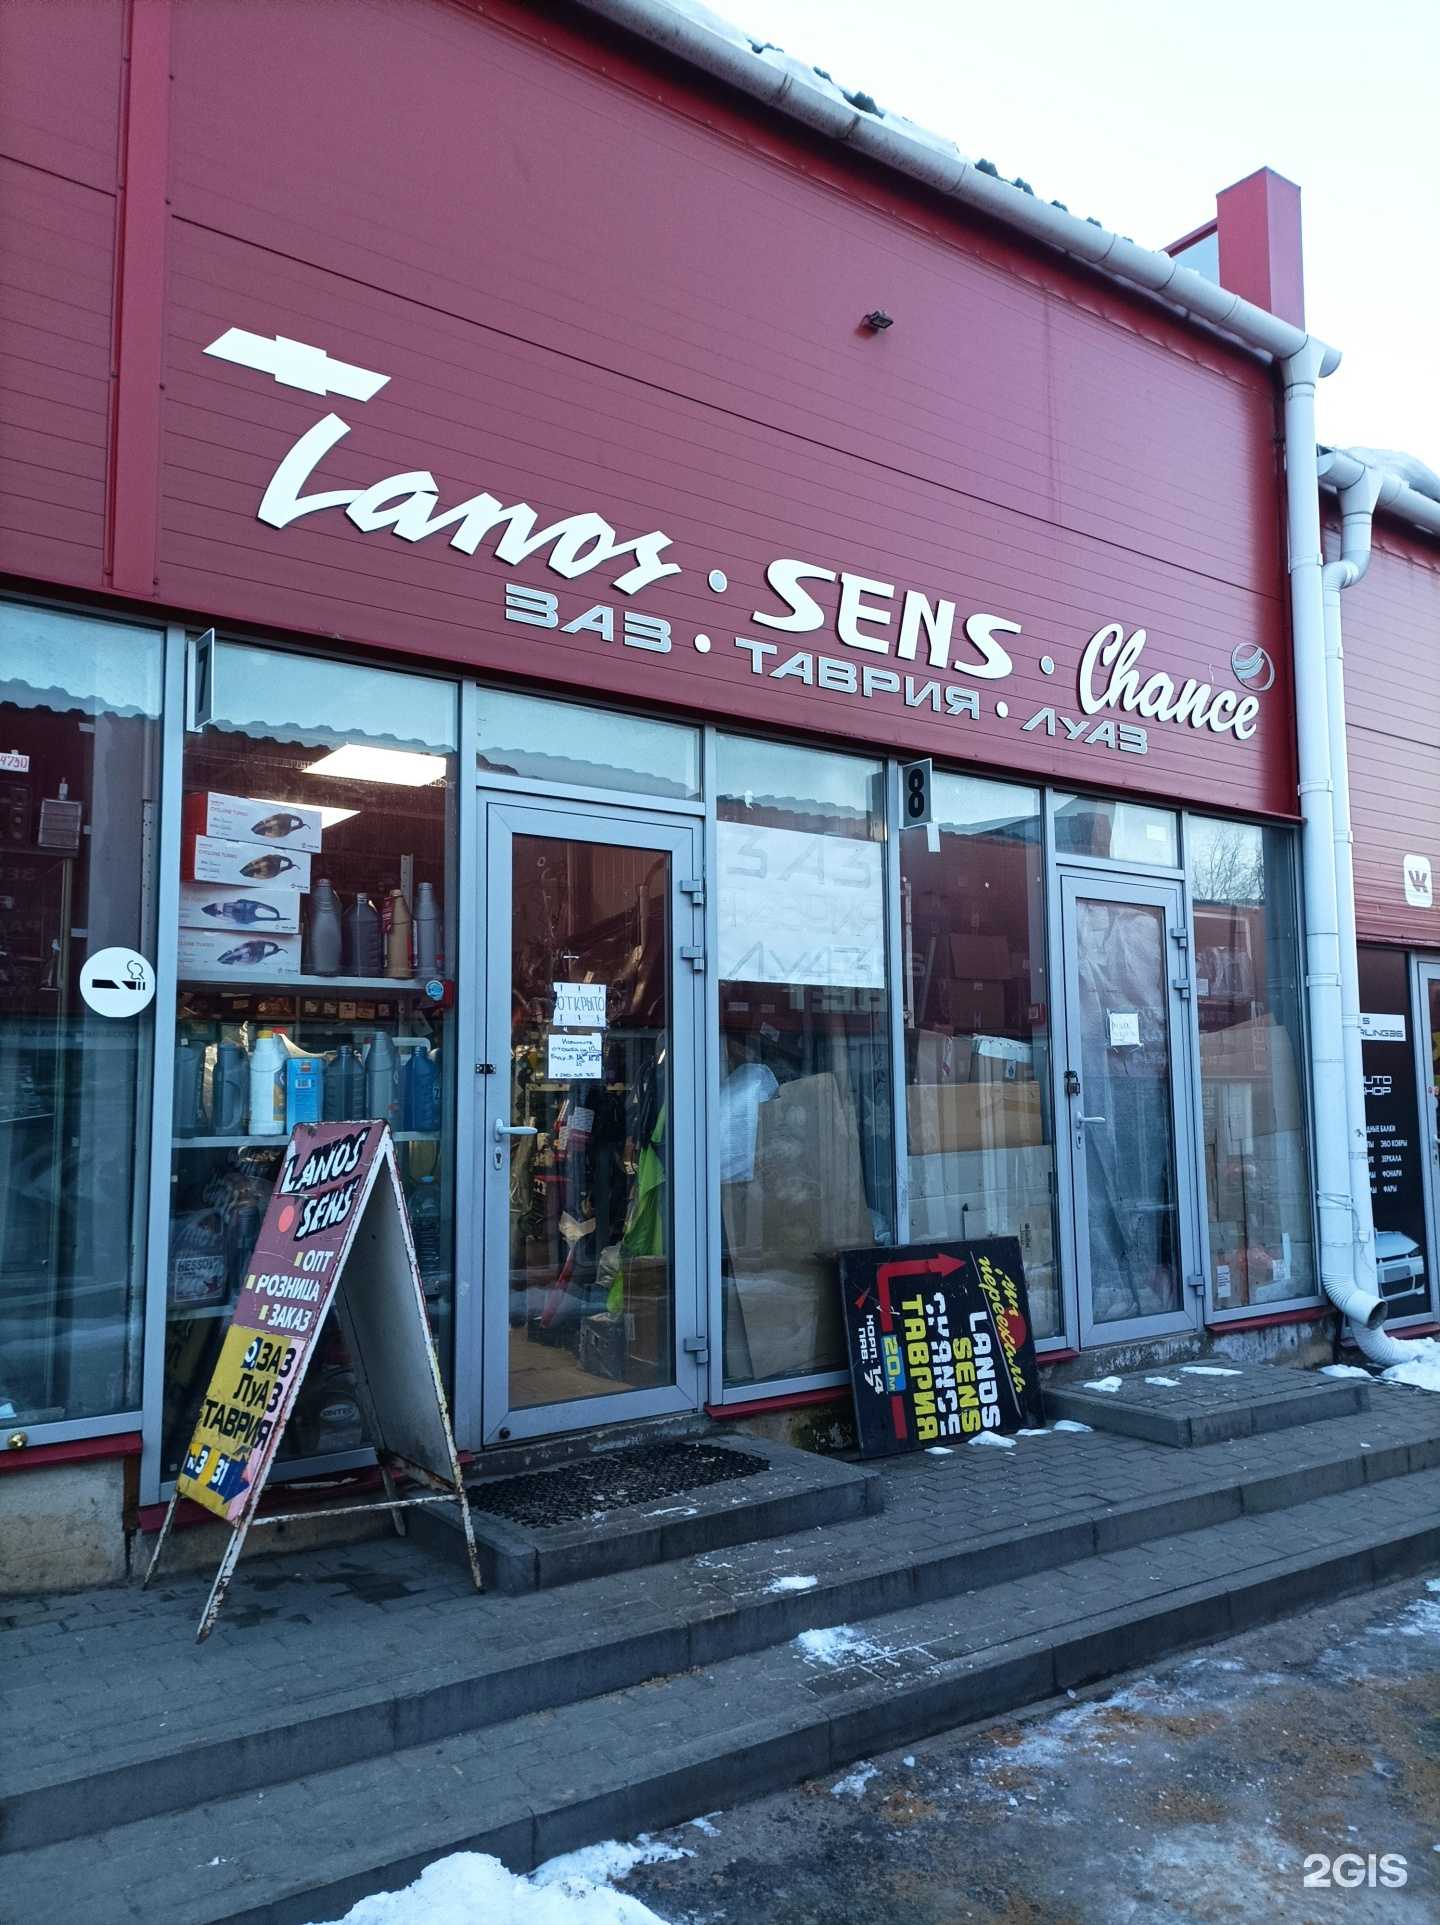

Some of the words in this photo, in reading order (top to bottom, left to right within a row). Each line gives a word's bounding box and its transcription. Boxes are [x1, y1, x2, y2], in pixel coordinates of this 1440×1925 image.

[257, 412, 682, 595] Lanos
[505, 582, 672, 653] ЗАЗ
[752, 558, 1022, 680] SENS
[734, 636, 980, 719] ТАВРИЯ
[1078, 622, 1260, 740] Chance
[908, 768, 925, 818] 8
[1364, 1075, 1392, 1085] UTO
[1364, 1086, 1391, 1096] HOP
[280, 1129, 370, 1193] LANOS
[295, 1177, 361, 1238] SENS
[255, 1274, 321, 1302] РОЗНИЦА
[302, 1249, 335, 1273] ОПТ
[267, 1303, 312, 1332] ЗАКАЗ
[256, 1342, 297, 1378] ЗАЗ
[901, 1293, 939, 1441] ТАВРИЯ
[952, 1336, 982, 1433] SENS
[202, 1398, 273, 1451] ТАВРИЯ
